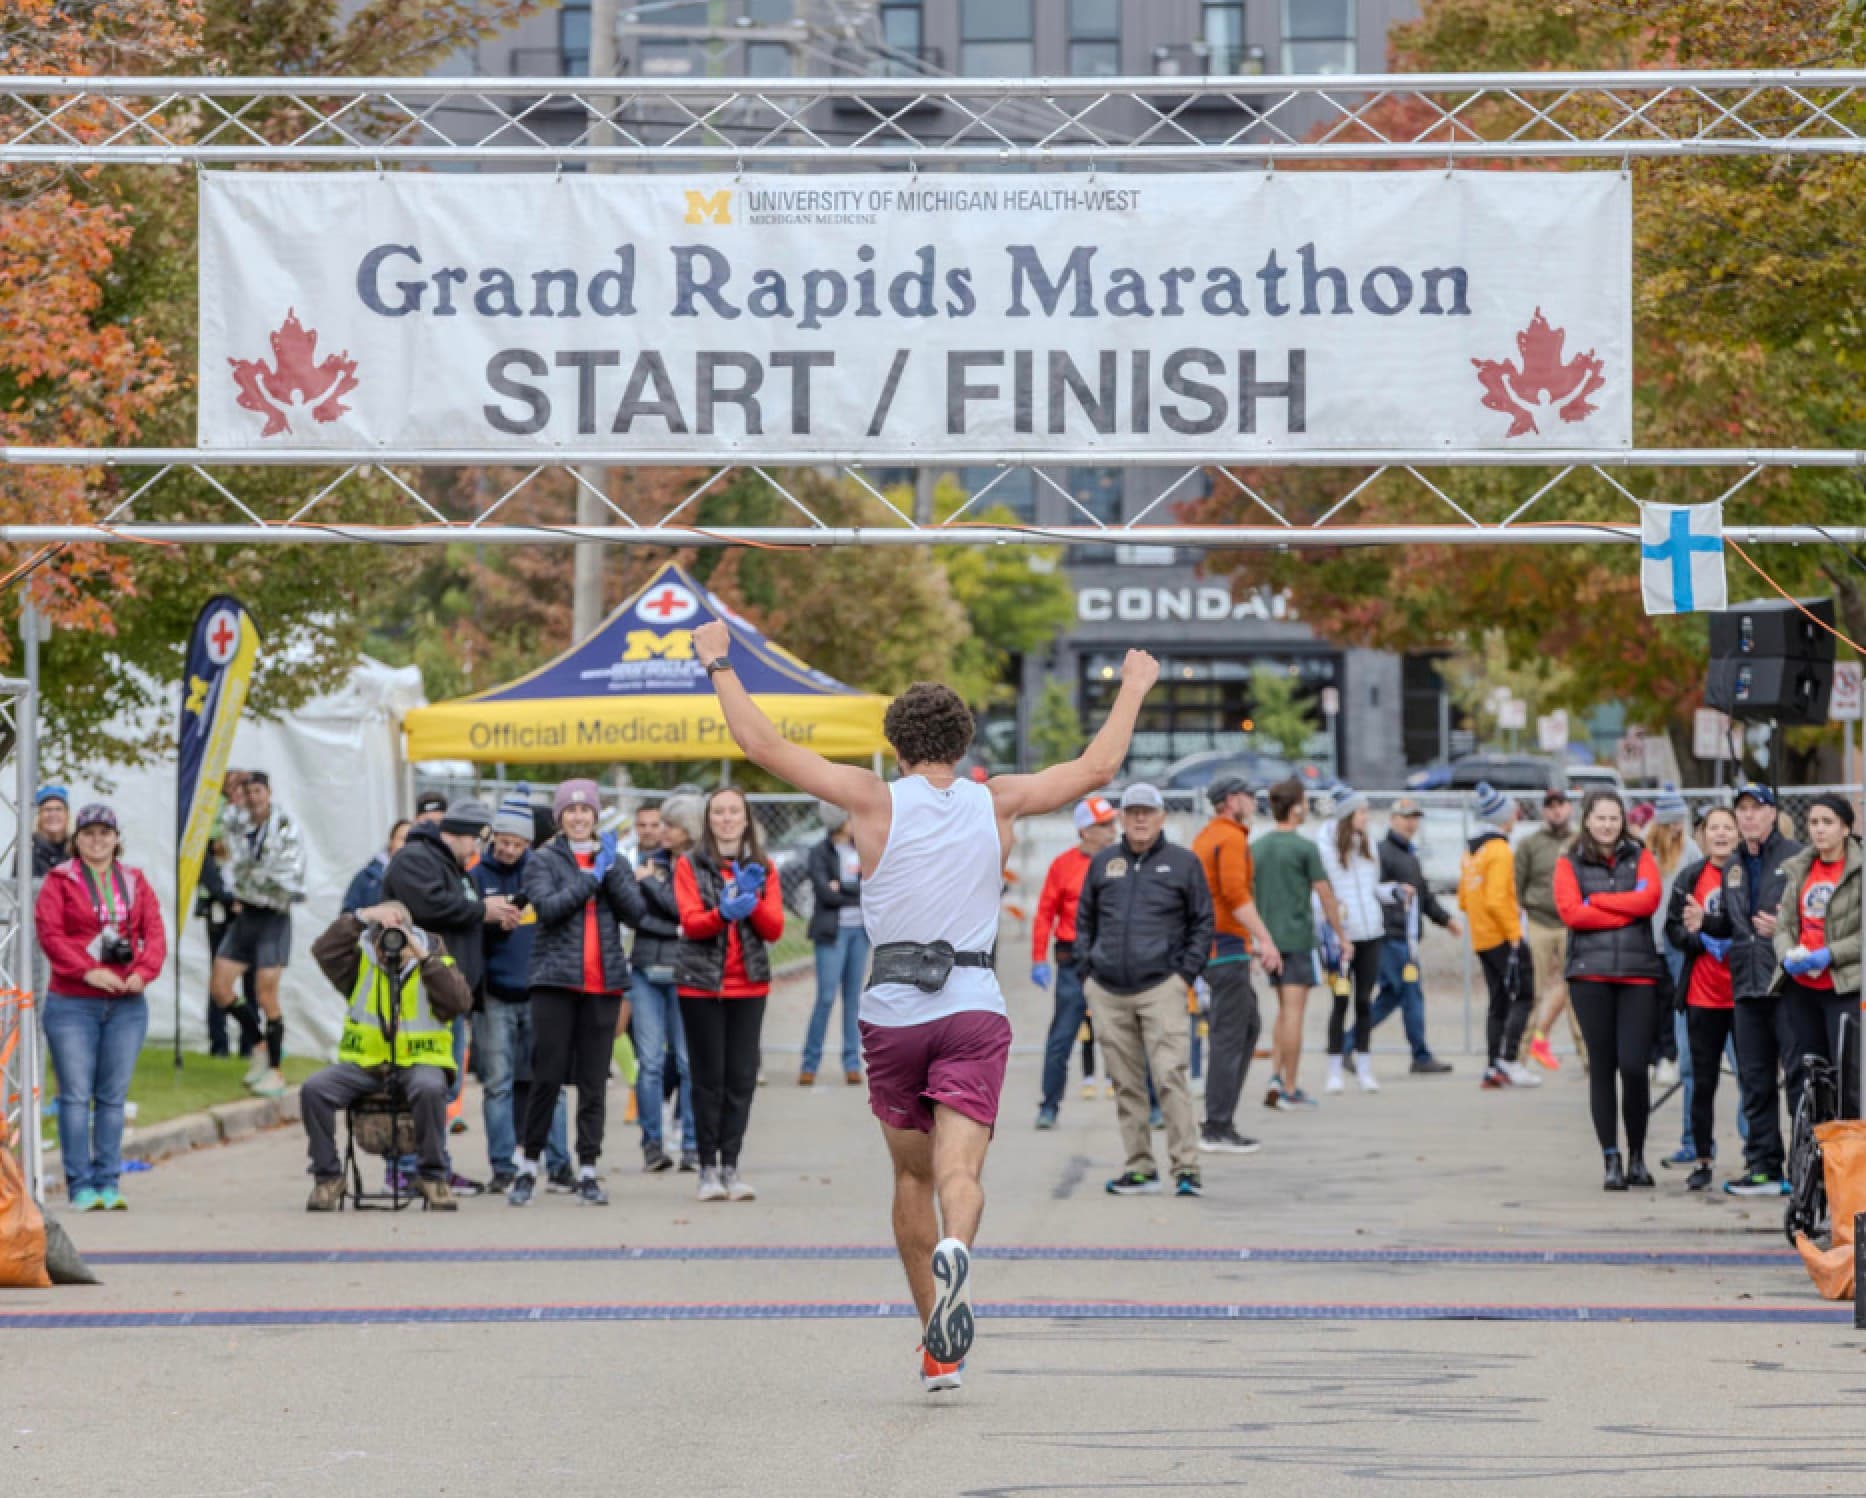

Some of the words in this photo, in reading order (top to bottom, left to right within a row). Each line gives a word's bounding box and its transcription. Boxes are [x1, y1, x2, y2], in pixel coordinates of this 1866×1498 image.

[684, 189, 732, 225] M
[749, 190, 864, 211] UNIVERSITY
[869, 190, 893, 211] OF
[897, 190, 997, 212] MICHIGAN
[1004, 190, 1141, 211] HEALTH-WEST
[750, 214, 812, 225] MICHIGAN
[356, 243, 637, 317] Grand
[670, 244, 977, 329] Rapids
[1005, 242, 1473, 317] Marathon
[483, 348, 835, 435] START
[866, 349, 911, 436] /
[947, 348, 1307, 435] FINISH
[622, 629, 695, 661] M
[469, 721, 567, 749] Official
[576, 717, 687, 745] Medical
